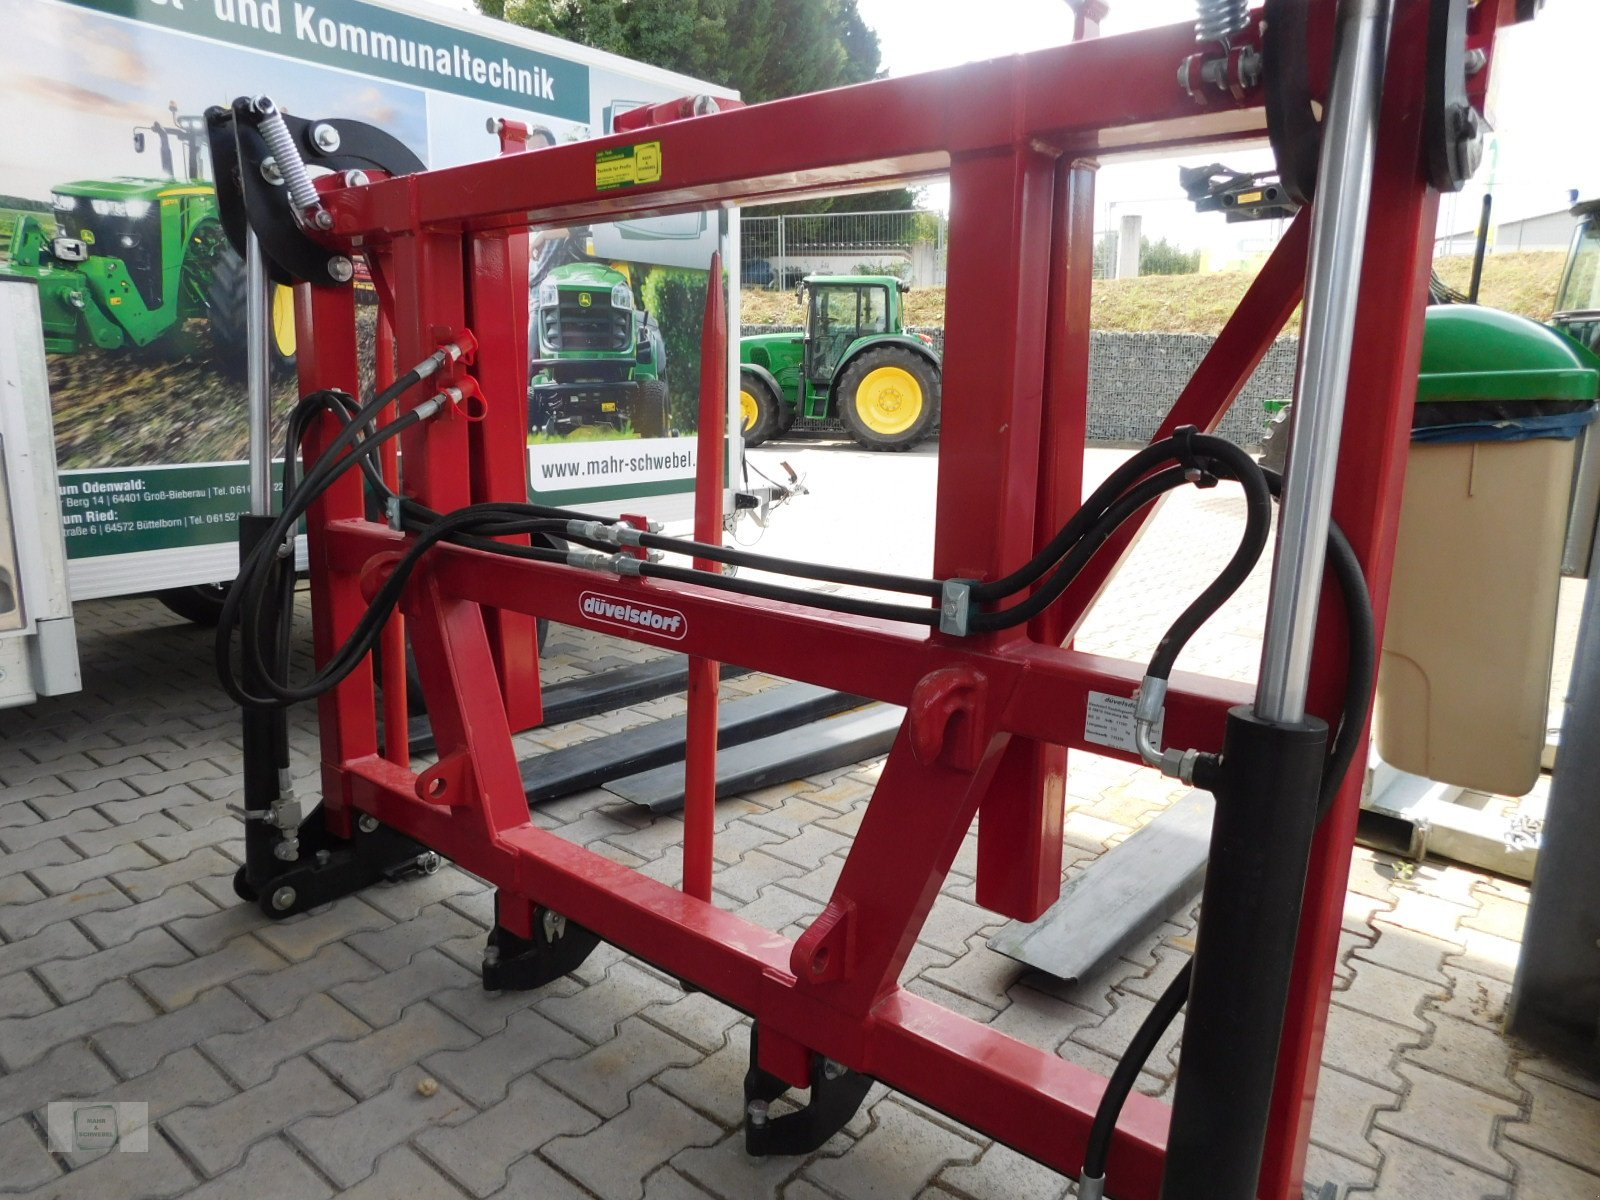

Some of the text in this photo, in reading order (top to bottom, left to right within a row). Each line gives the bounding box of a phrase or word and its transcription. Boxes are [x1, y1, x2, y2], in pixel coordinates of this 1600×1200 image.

[213, 0, 555, 101] und Kommunaltechnik
[541, 450, 696, 479] www.mahr-schwebel.
[59, 478, 146, 496] um Odenwald:
[66, 497, 90, 508] Berg
[92, 495, 104, 506] 14
[112, 492, 141, 504] 64401
[143, 488, 206, 502] Groß-Bieberau
[212, 486, 228, 496] Tel.
[273, 482, 284, 492] 22
[63, 509, 119, 525] um Ried:
[63, 511, 250, 537] traße 6 64572 Büttelborn Tel. 06152/
[583, 597, 681, 632] düvelsdorf
